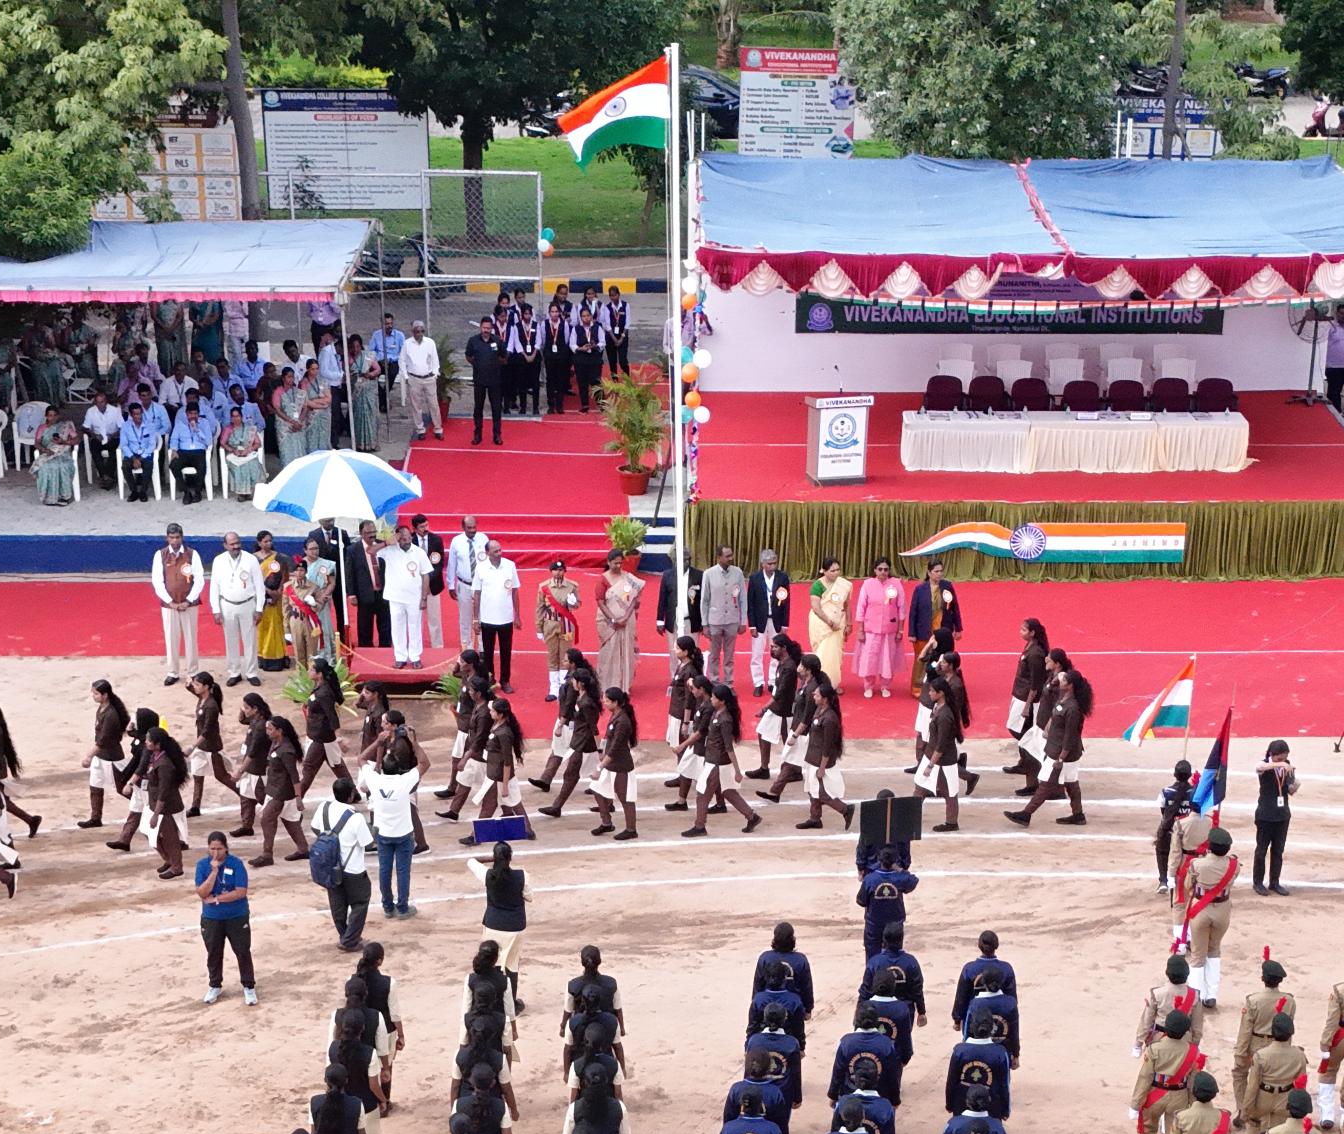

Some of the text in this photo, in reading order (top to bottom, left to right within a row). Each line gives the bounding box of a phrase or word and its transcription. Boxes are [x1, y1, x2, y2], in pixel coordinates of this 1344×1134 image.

[765, 51, 836, 61] VIVEKANANDHA
[844, 305, 969, 322] VIVEKANANDHA
[1091, 307, 1204, 324] INSTITUTIONS
[825, 398, 872, 406] VIVEKANANDHA
